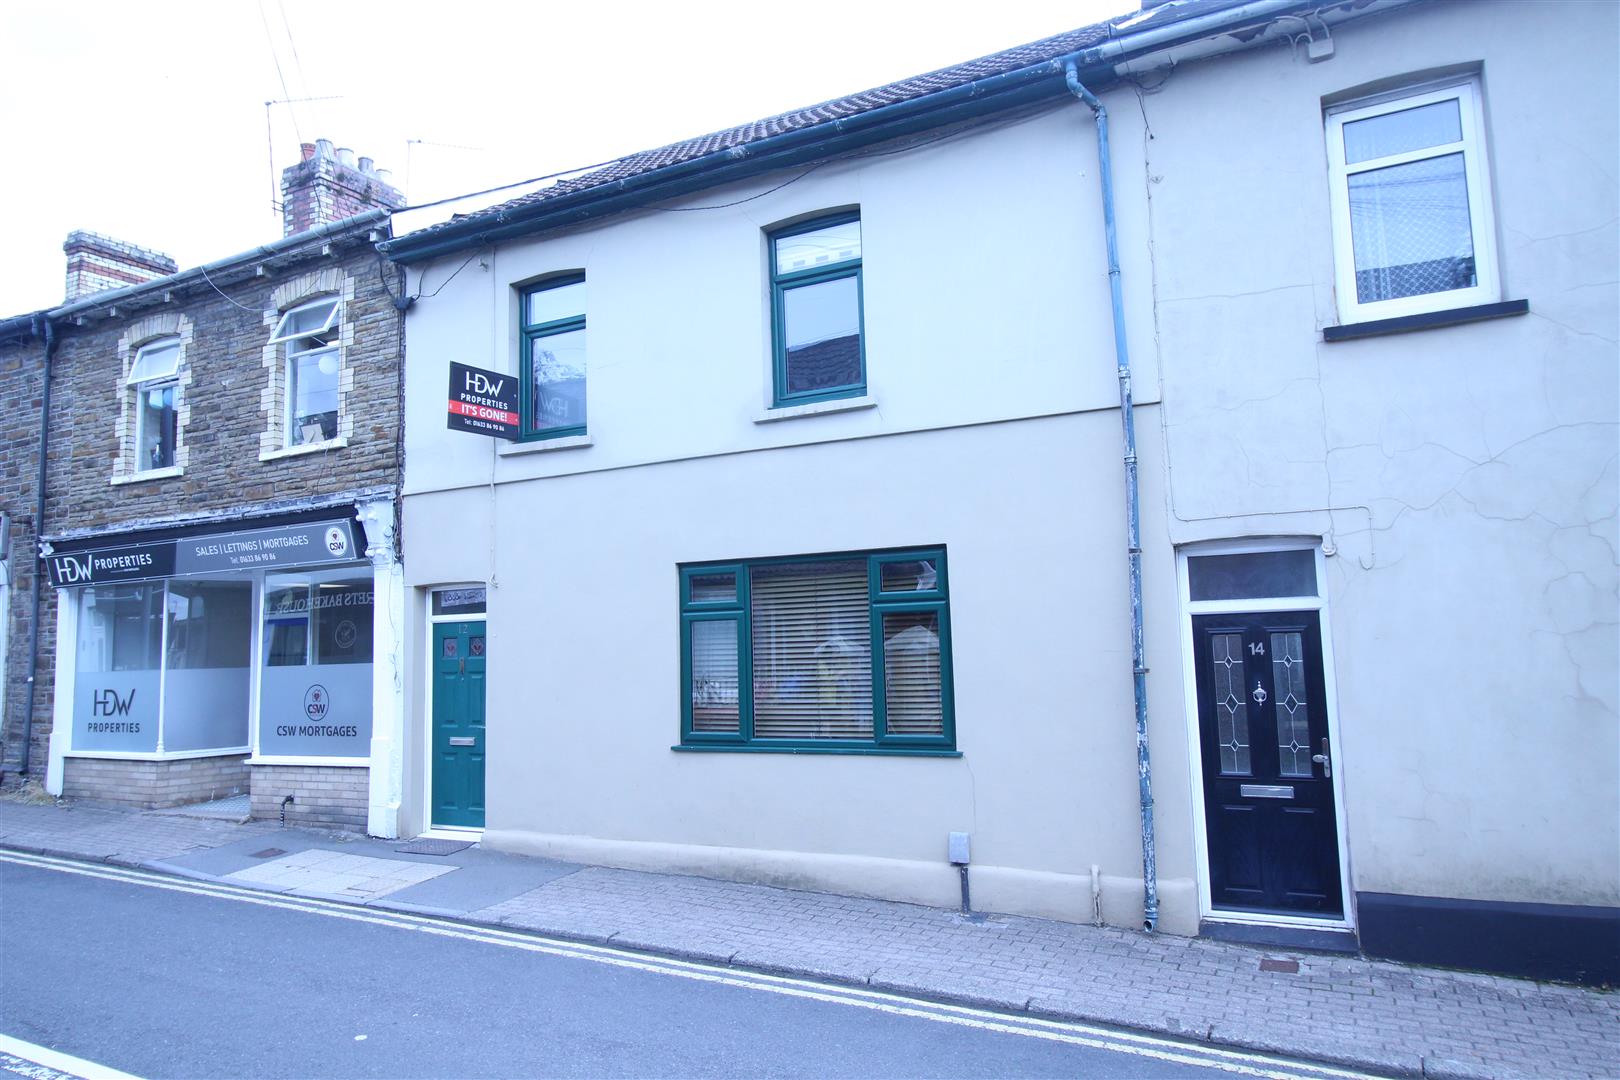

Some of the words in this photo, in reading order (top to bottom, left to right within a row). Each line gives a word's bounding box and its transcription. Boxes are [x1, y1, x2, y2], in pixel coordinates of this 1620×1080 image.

[465, 370, 504, 398] HDW
[460, 393, 508, 410] PROPERTIES
[461, 403, 478, 416] IT'S
[479, 408, 508, 422] GONE!
[195, 545, 219, 557] SALES
[224, 540, 258, 554] LETTINGS
[264, 535, 309, 549] MORTGAGES
[329, 541, 345, 552] CSW
[94, 553, 153, 570] PROPERTIES
[240, 555, 254, 563] 01633
[254, 554, 261, 562] 86
[262, 553, 268, 561] 90
[54, 554, 93, 583] HDW
[458, 623, 469, 634] 12
[1248, 642, 1265, 655] 14
[93, 688, 136, 717] HDW
[307, 703, 326, 714] CSW
[87, 722, 140, 733] PROPERTIES
[276, 725, 297, 737] CSW
[298, 725, 357, 737] MORTGAGES
